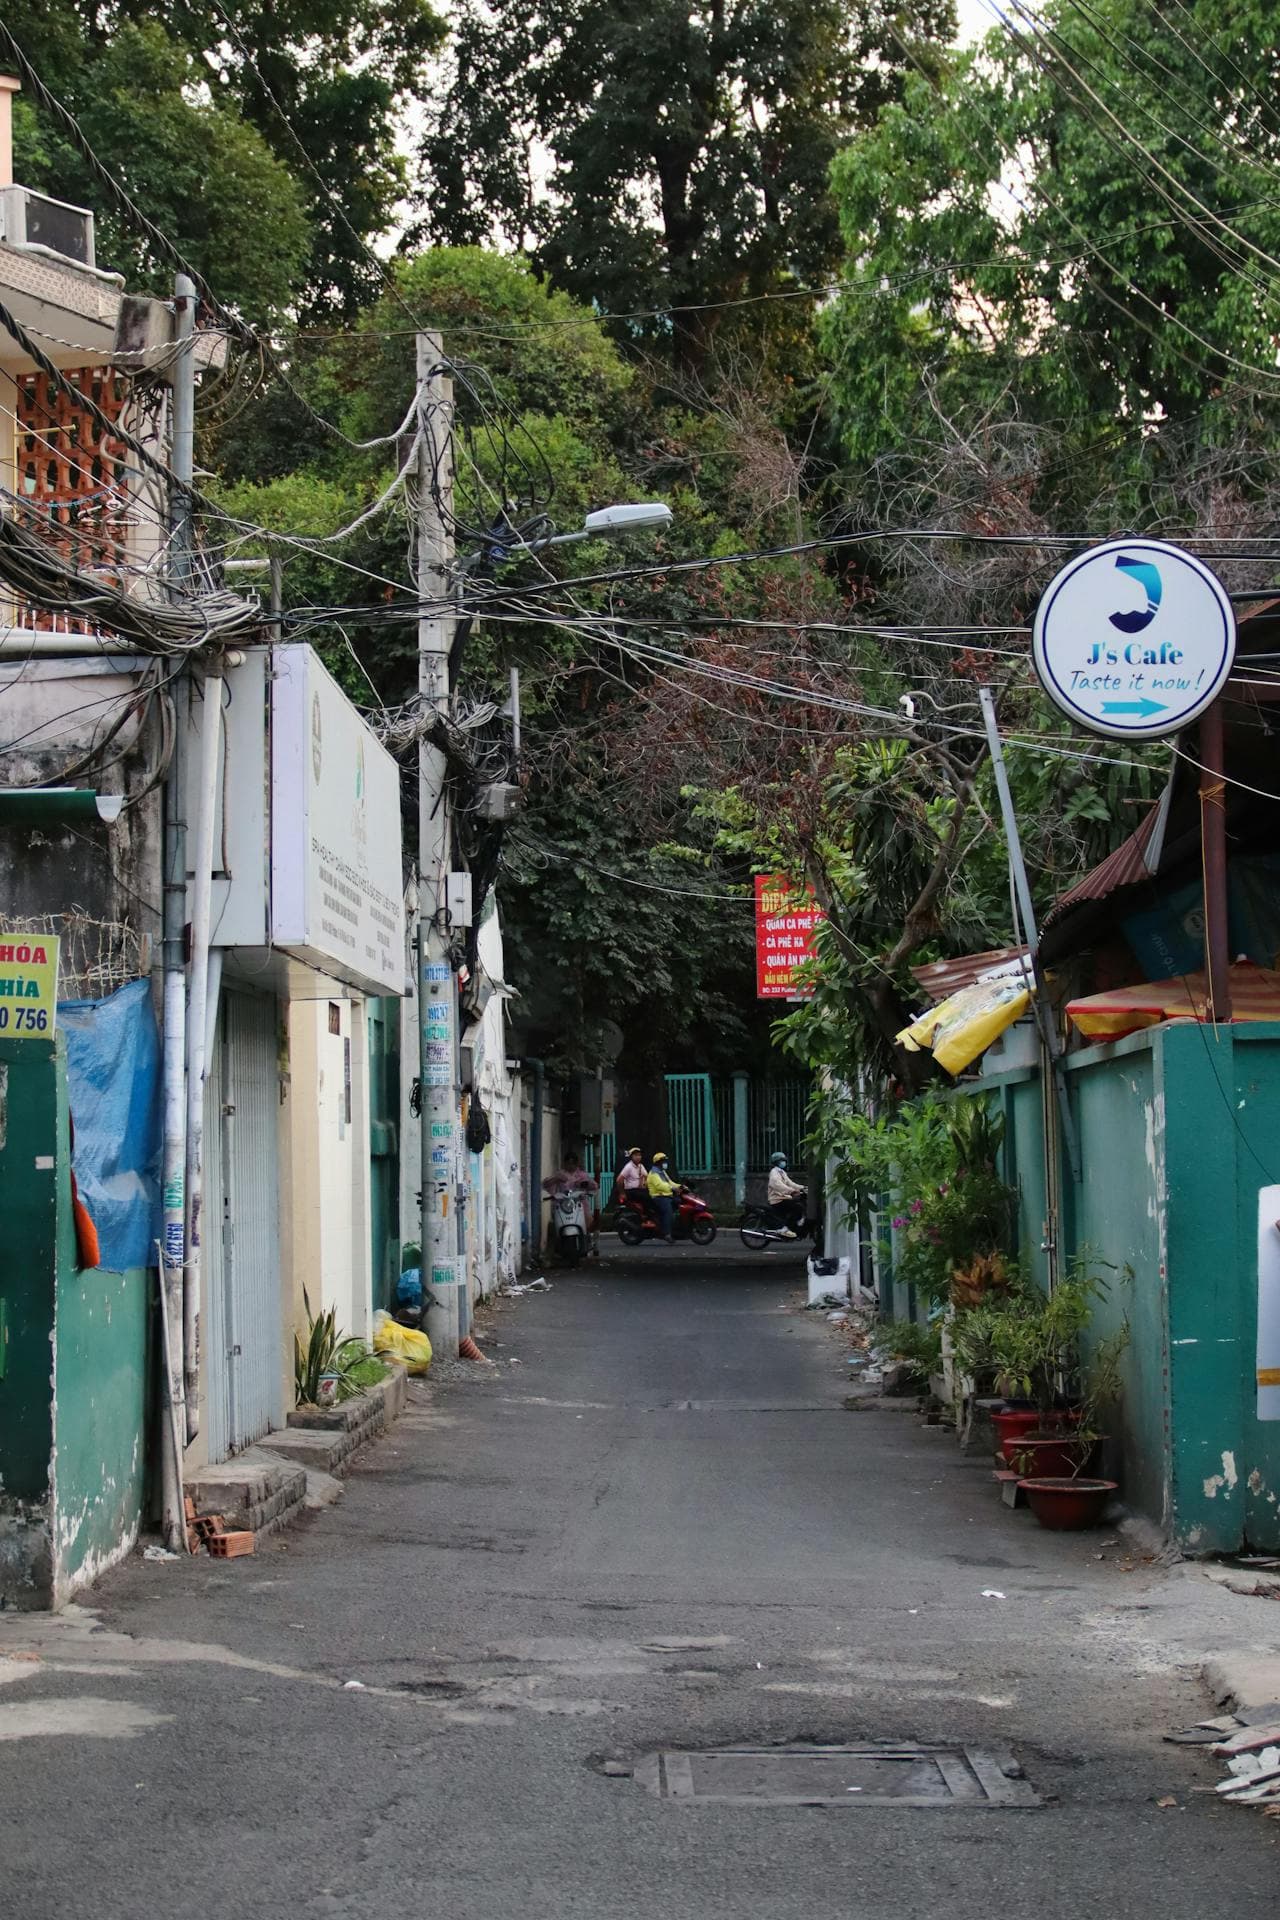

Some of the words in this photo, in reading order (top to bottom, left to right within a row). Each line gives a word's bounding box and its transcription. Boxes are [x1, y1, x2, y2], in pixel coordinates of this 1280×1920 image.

[1086, 641, 1118, 665] J's
[1124, 641, 1184, 665] Cafe
[1070, 670, 1121, 690] Taste
[1129, 672, 1145, 690] it
[15, 1008, 47, 1031] 756
